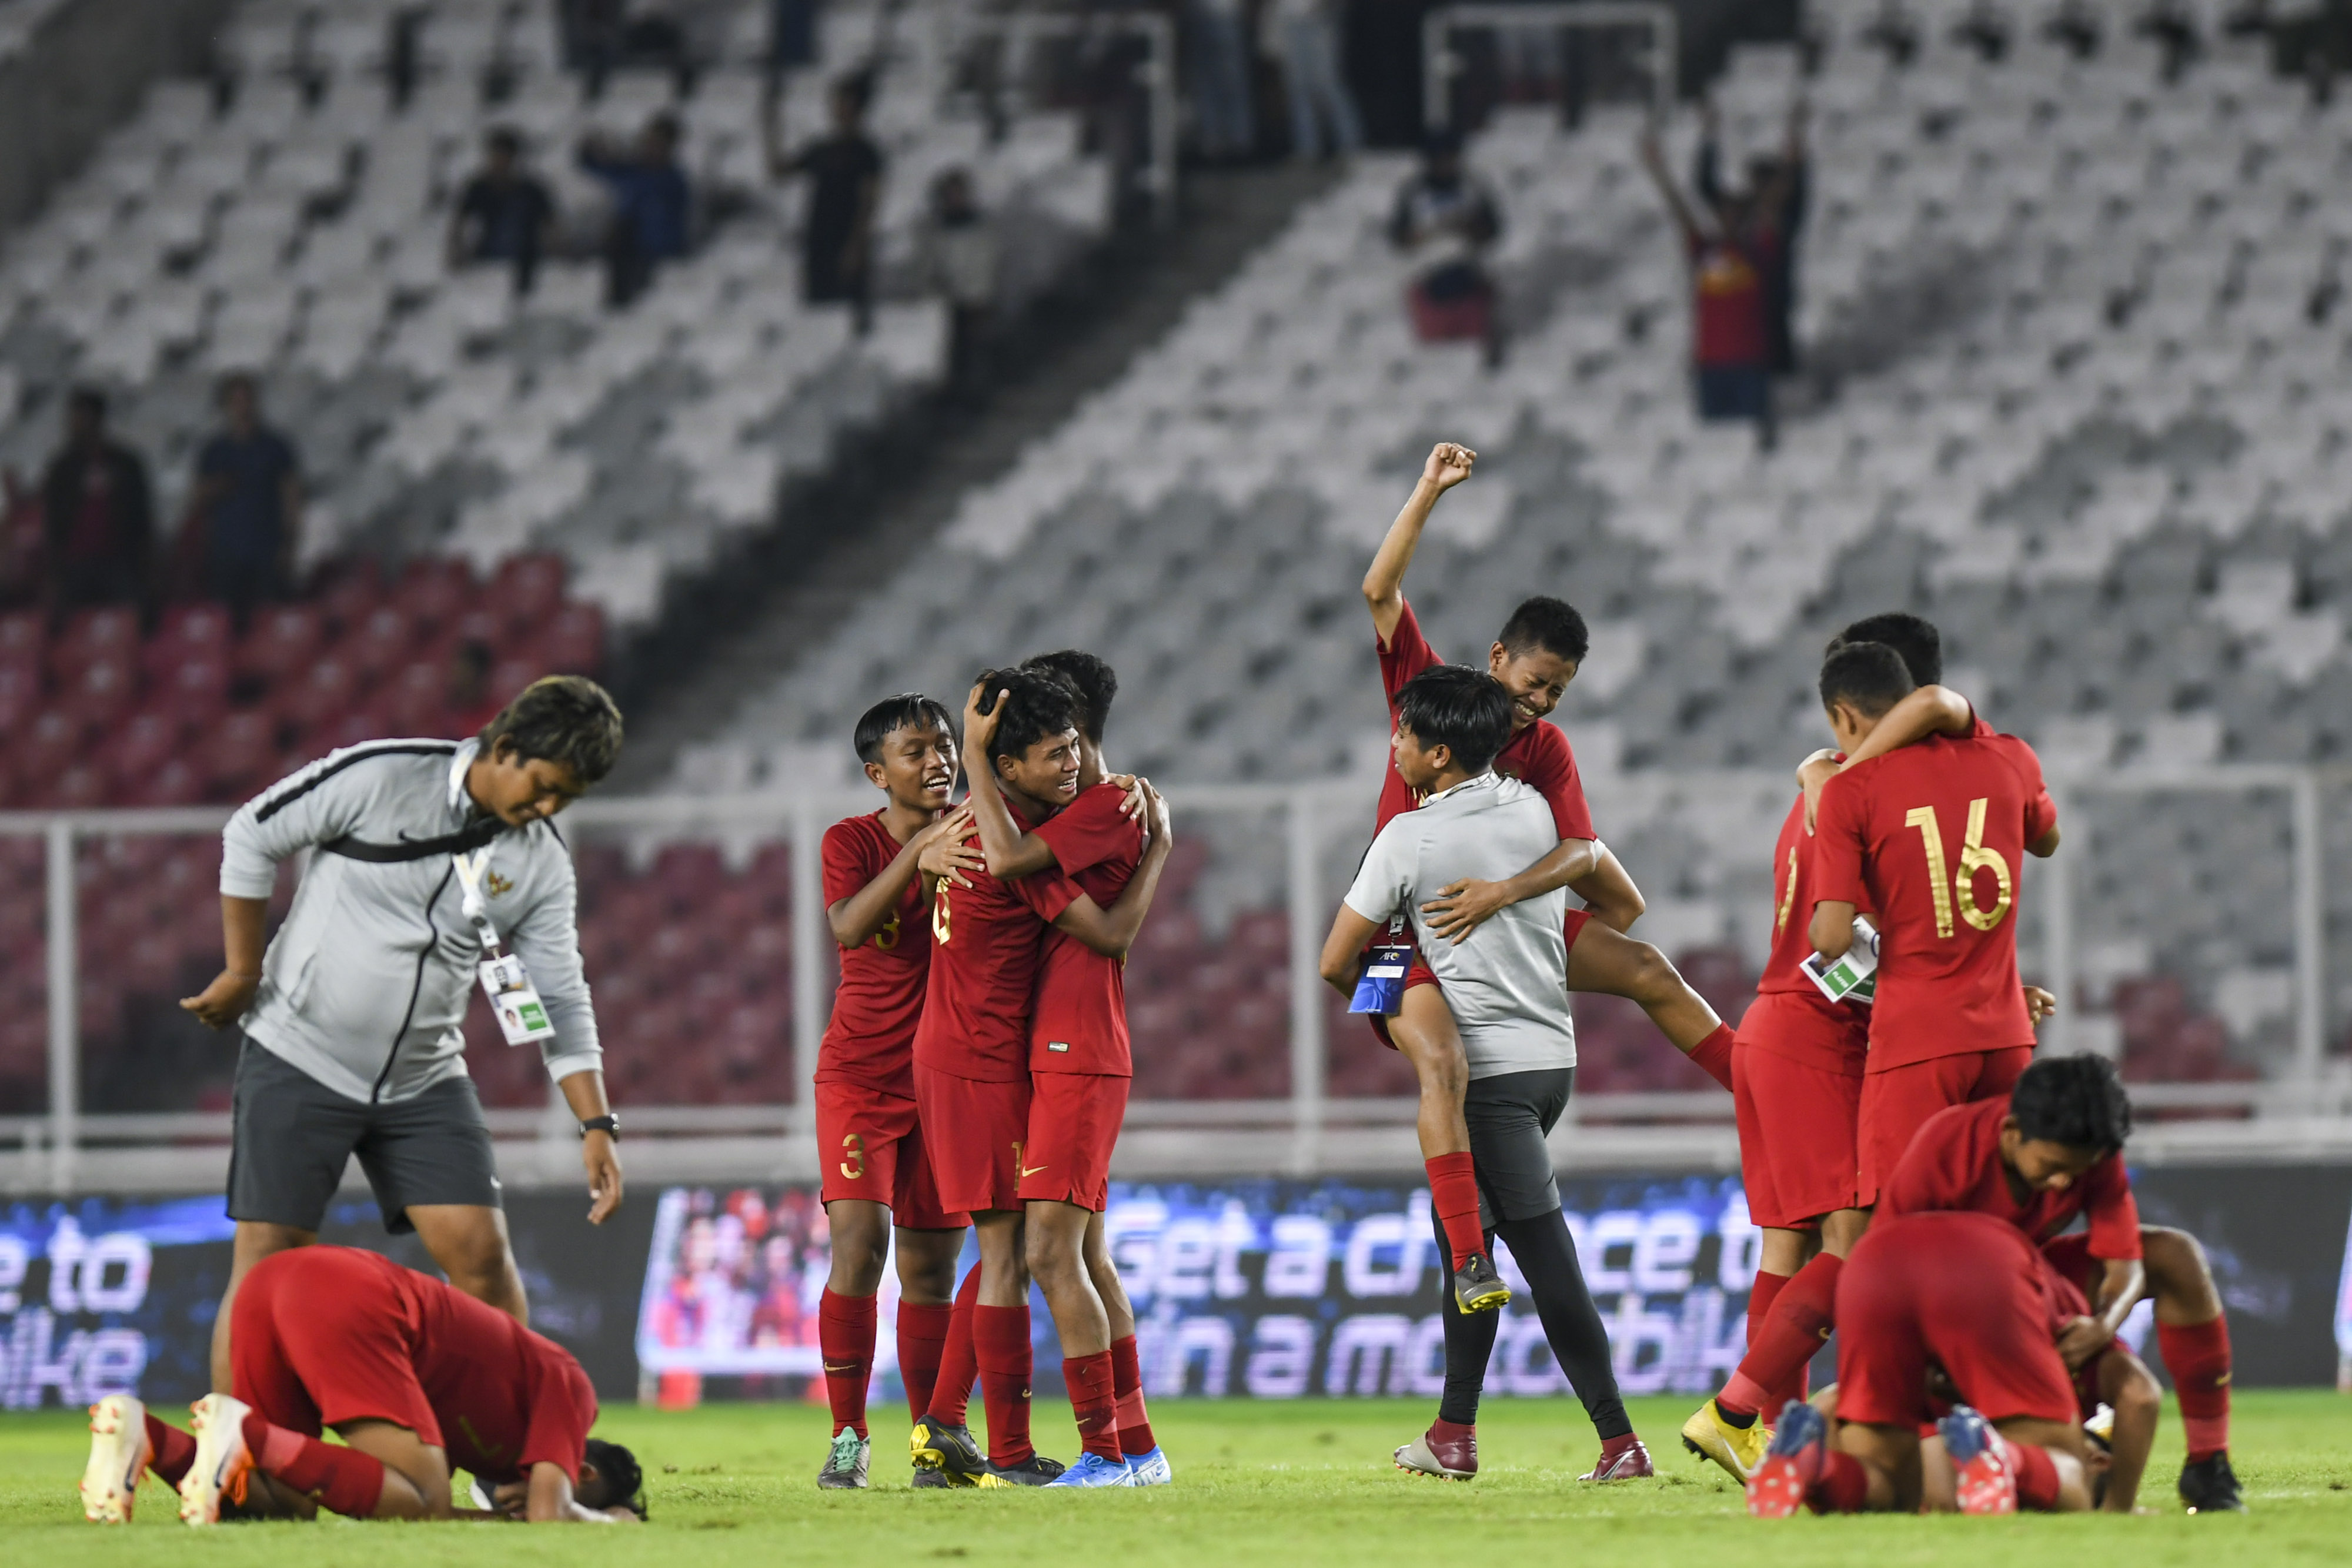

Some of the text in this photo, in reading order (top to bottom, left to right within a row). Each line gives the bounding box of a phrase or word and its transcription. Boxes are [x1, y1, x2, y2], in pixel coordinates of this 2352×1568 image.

[1905, 798, 2011, 938] 16
[1379, 952, 1398, 961] AFC
[840, 1133, 864, 1179] 3
[47, 1213, 152, 1313] to
[1262, 1213, 1332, 1298] a
[1343, 1186, 1699, 1298] chce
[0, 1303, 148, 1410] ike
[1244, 1315, 1316, 1398] a
